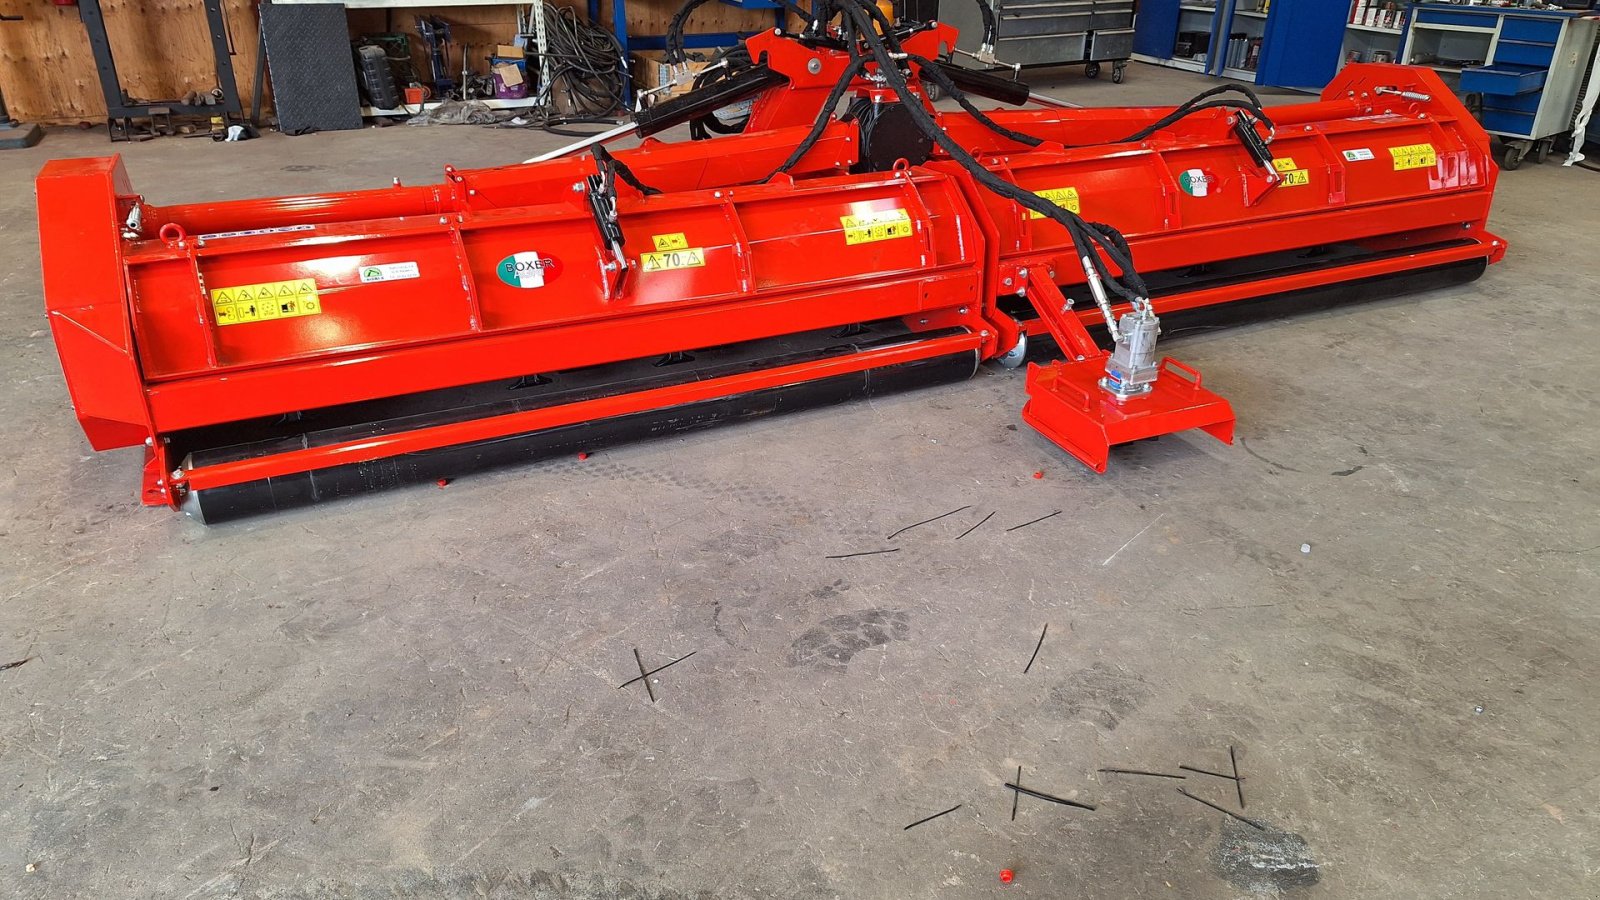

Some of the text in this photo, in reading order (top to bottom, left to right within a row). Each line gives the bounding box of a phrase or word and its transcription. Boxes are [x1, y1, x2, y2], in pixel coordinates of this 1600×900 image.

[1184, 174, 1214, 184] BOXER
[505, 258, 555, 273] BOXER
[663, 253, 680, 267] 70
